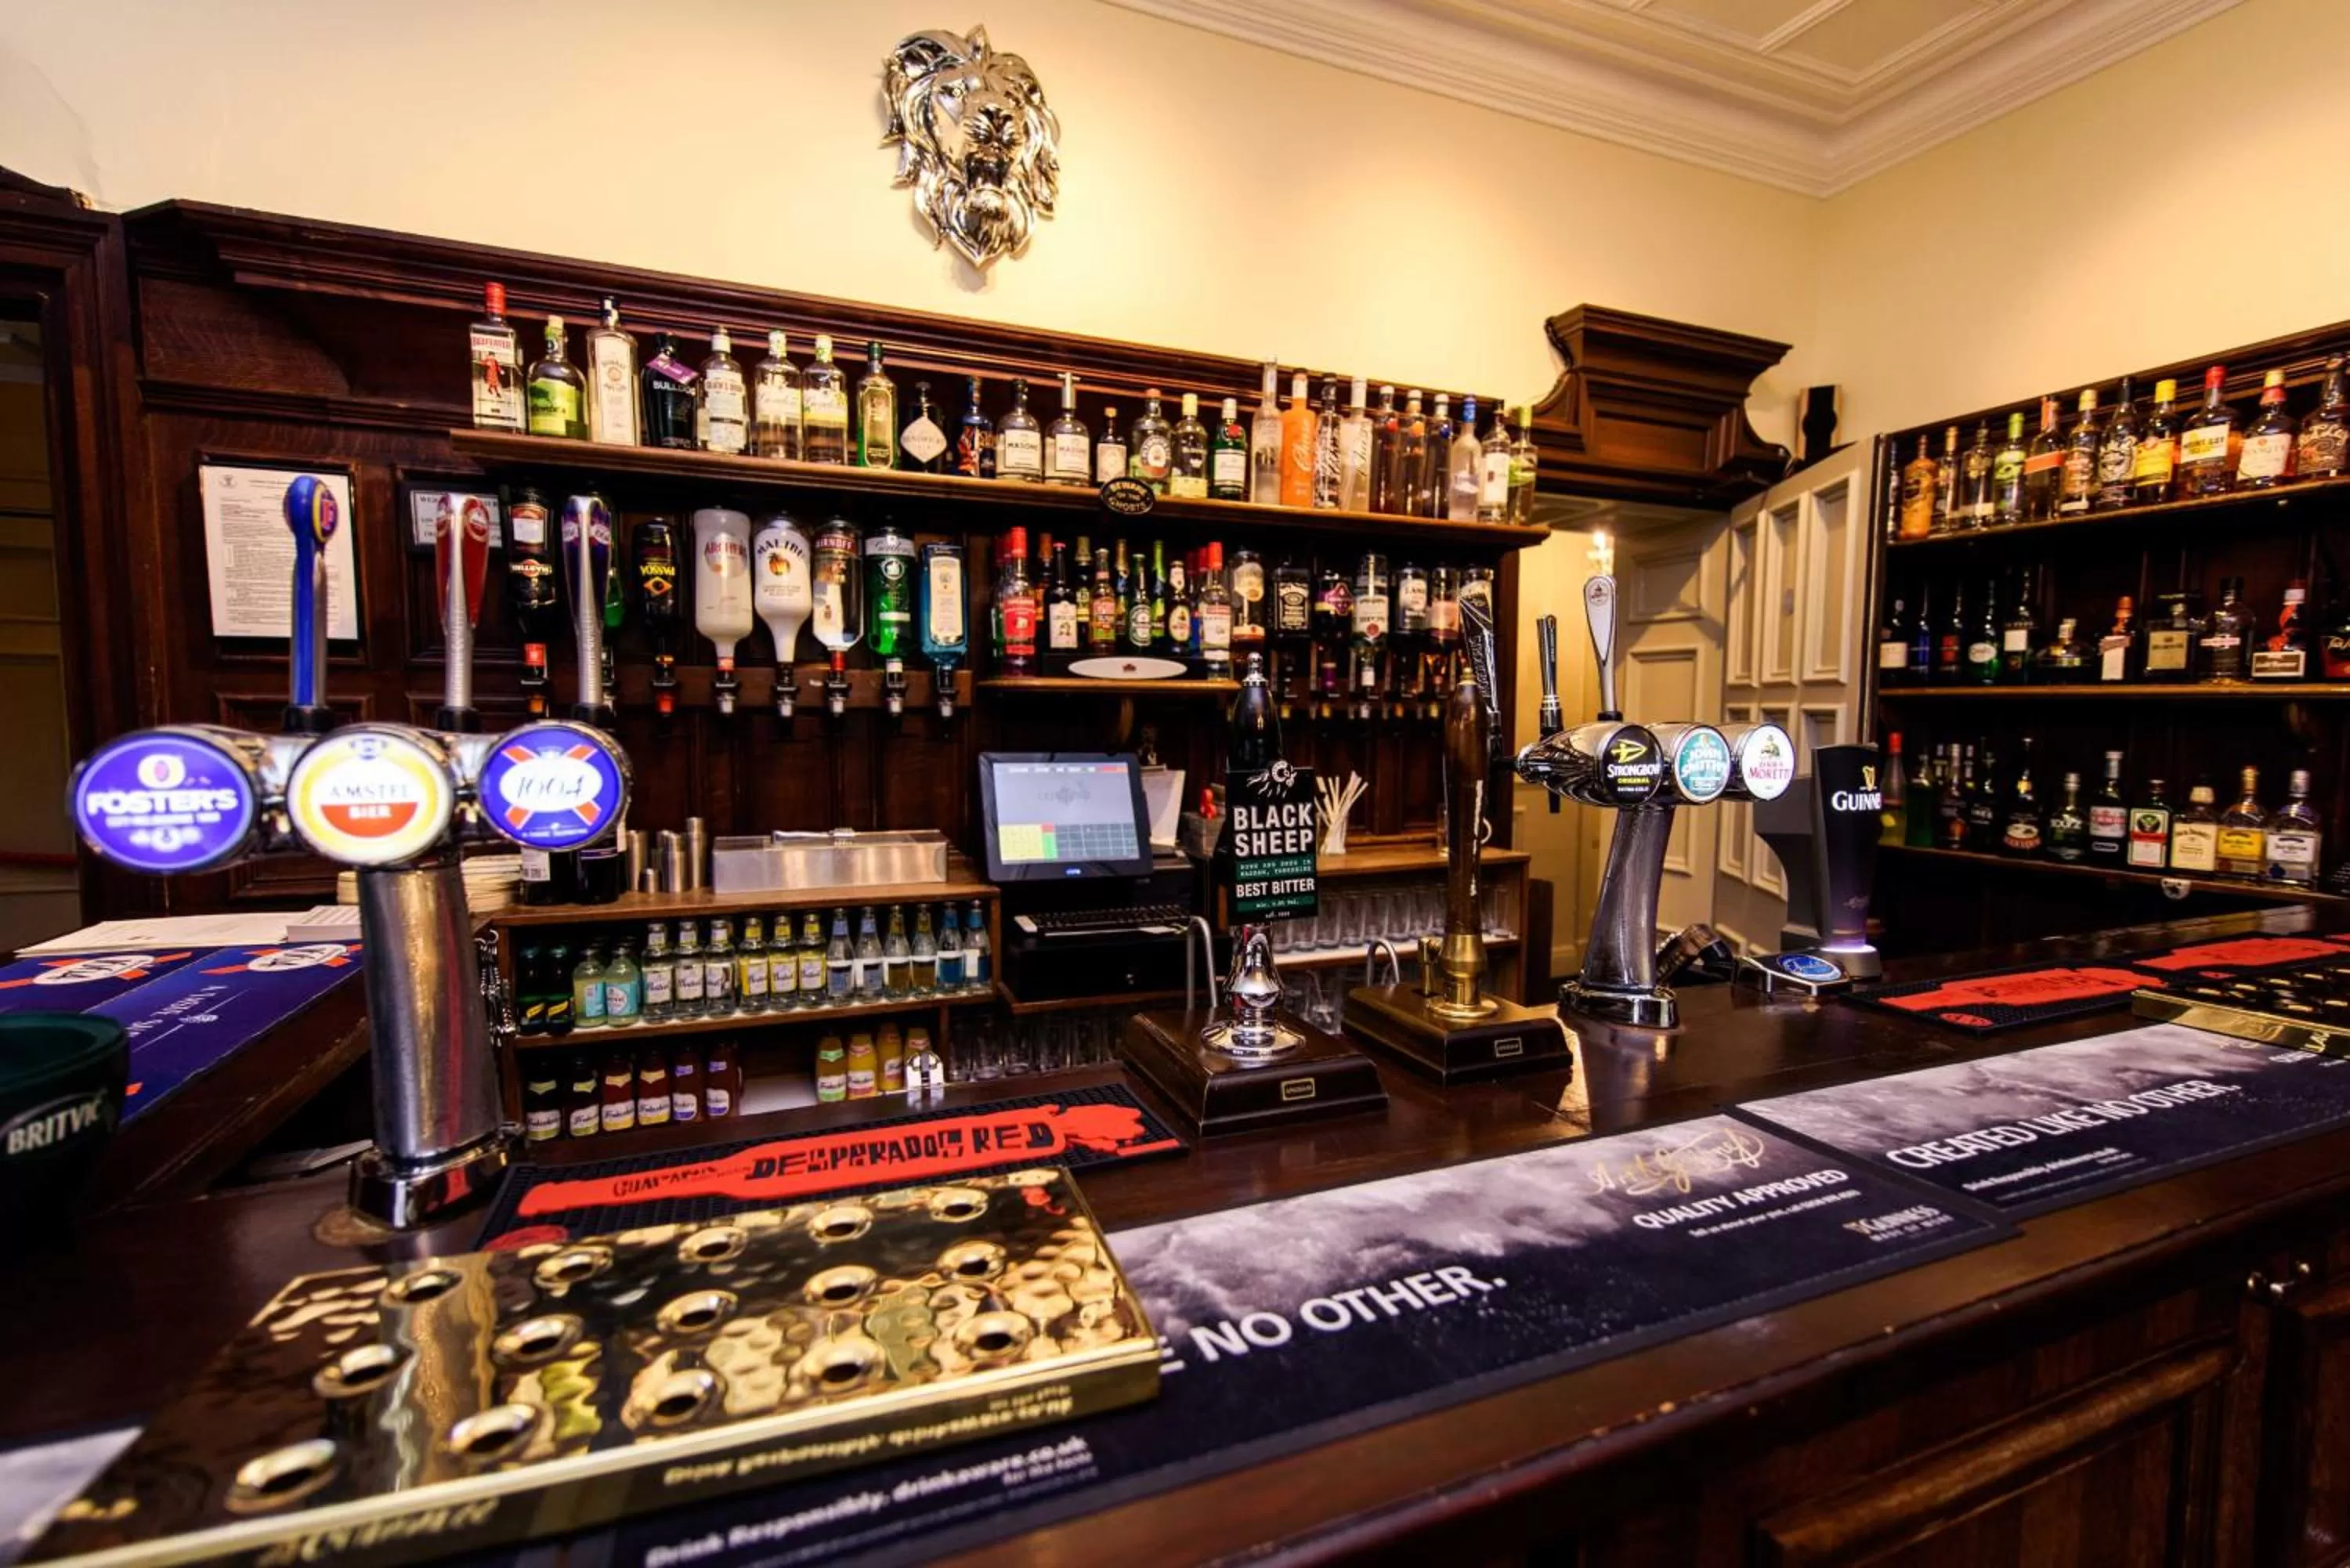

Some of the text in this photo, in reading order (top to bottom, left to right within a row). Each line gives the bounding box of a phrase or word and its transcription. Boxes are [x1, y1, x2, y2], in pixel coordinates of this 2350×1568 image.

[1607, 764, 1660, 778] STRONGBOW
[1748, 766, 1791, 780] MORETTI
[86, 789, 238, 816] FOSTER'S
[328, 782, 409, 798] AMSTEL
[348, 804, 392, 819] BIER
[1233, 801, 1314, 831] BLACK
[1235, 829, 1314, 857] SHEEP
[1236, 878, 1314, 898] BEST BITTER
[971, 1121, 1056, 1154] RED
[1886, 1125, 2038, 1168] CREATED
[2017, 1109, 2109, 1136] LIKE
[2080, 1100, 2149, 1121] NO
[1632, 1194, 1737, 1229] QUALITY
[1731, 1169, 1849, 1206] APPROVED
[1188, 1311, 1292, 1362] NO
[1300, 1266, 1508, 1331] OTHER.
